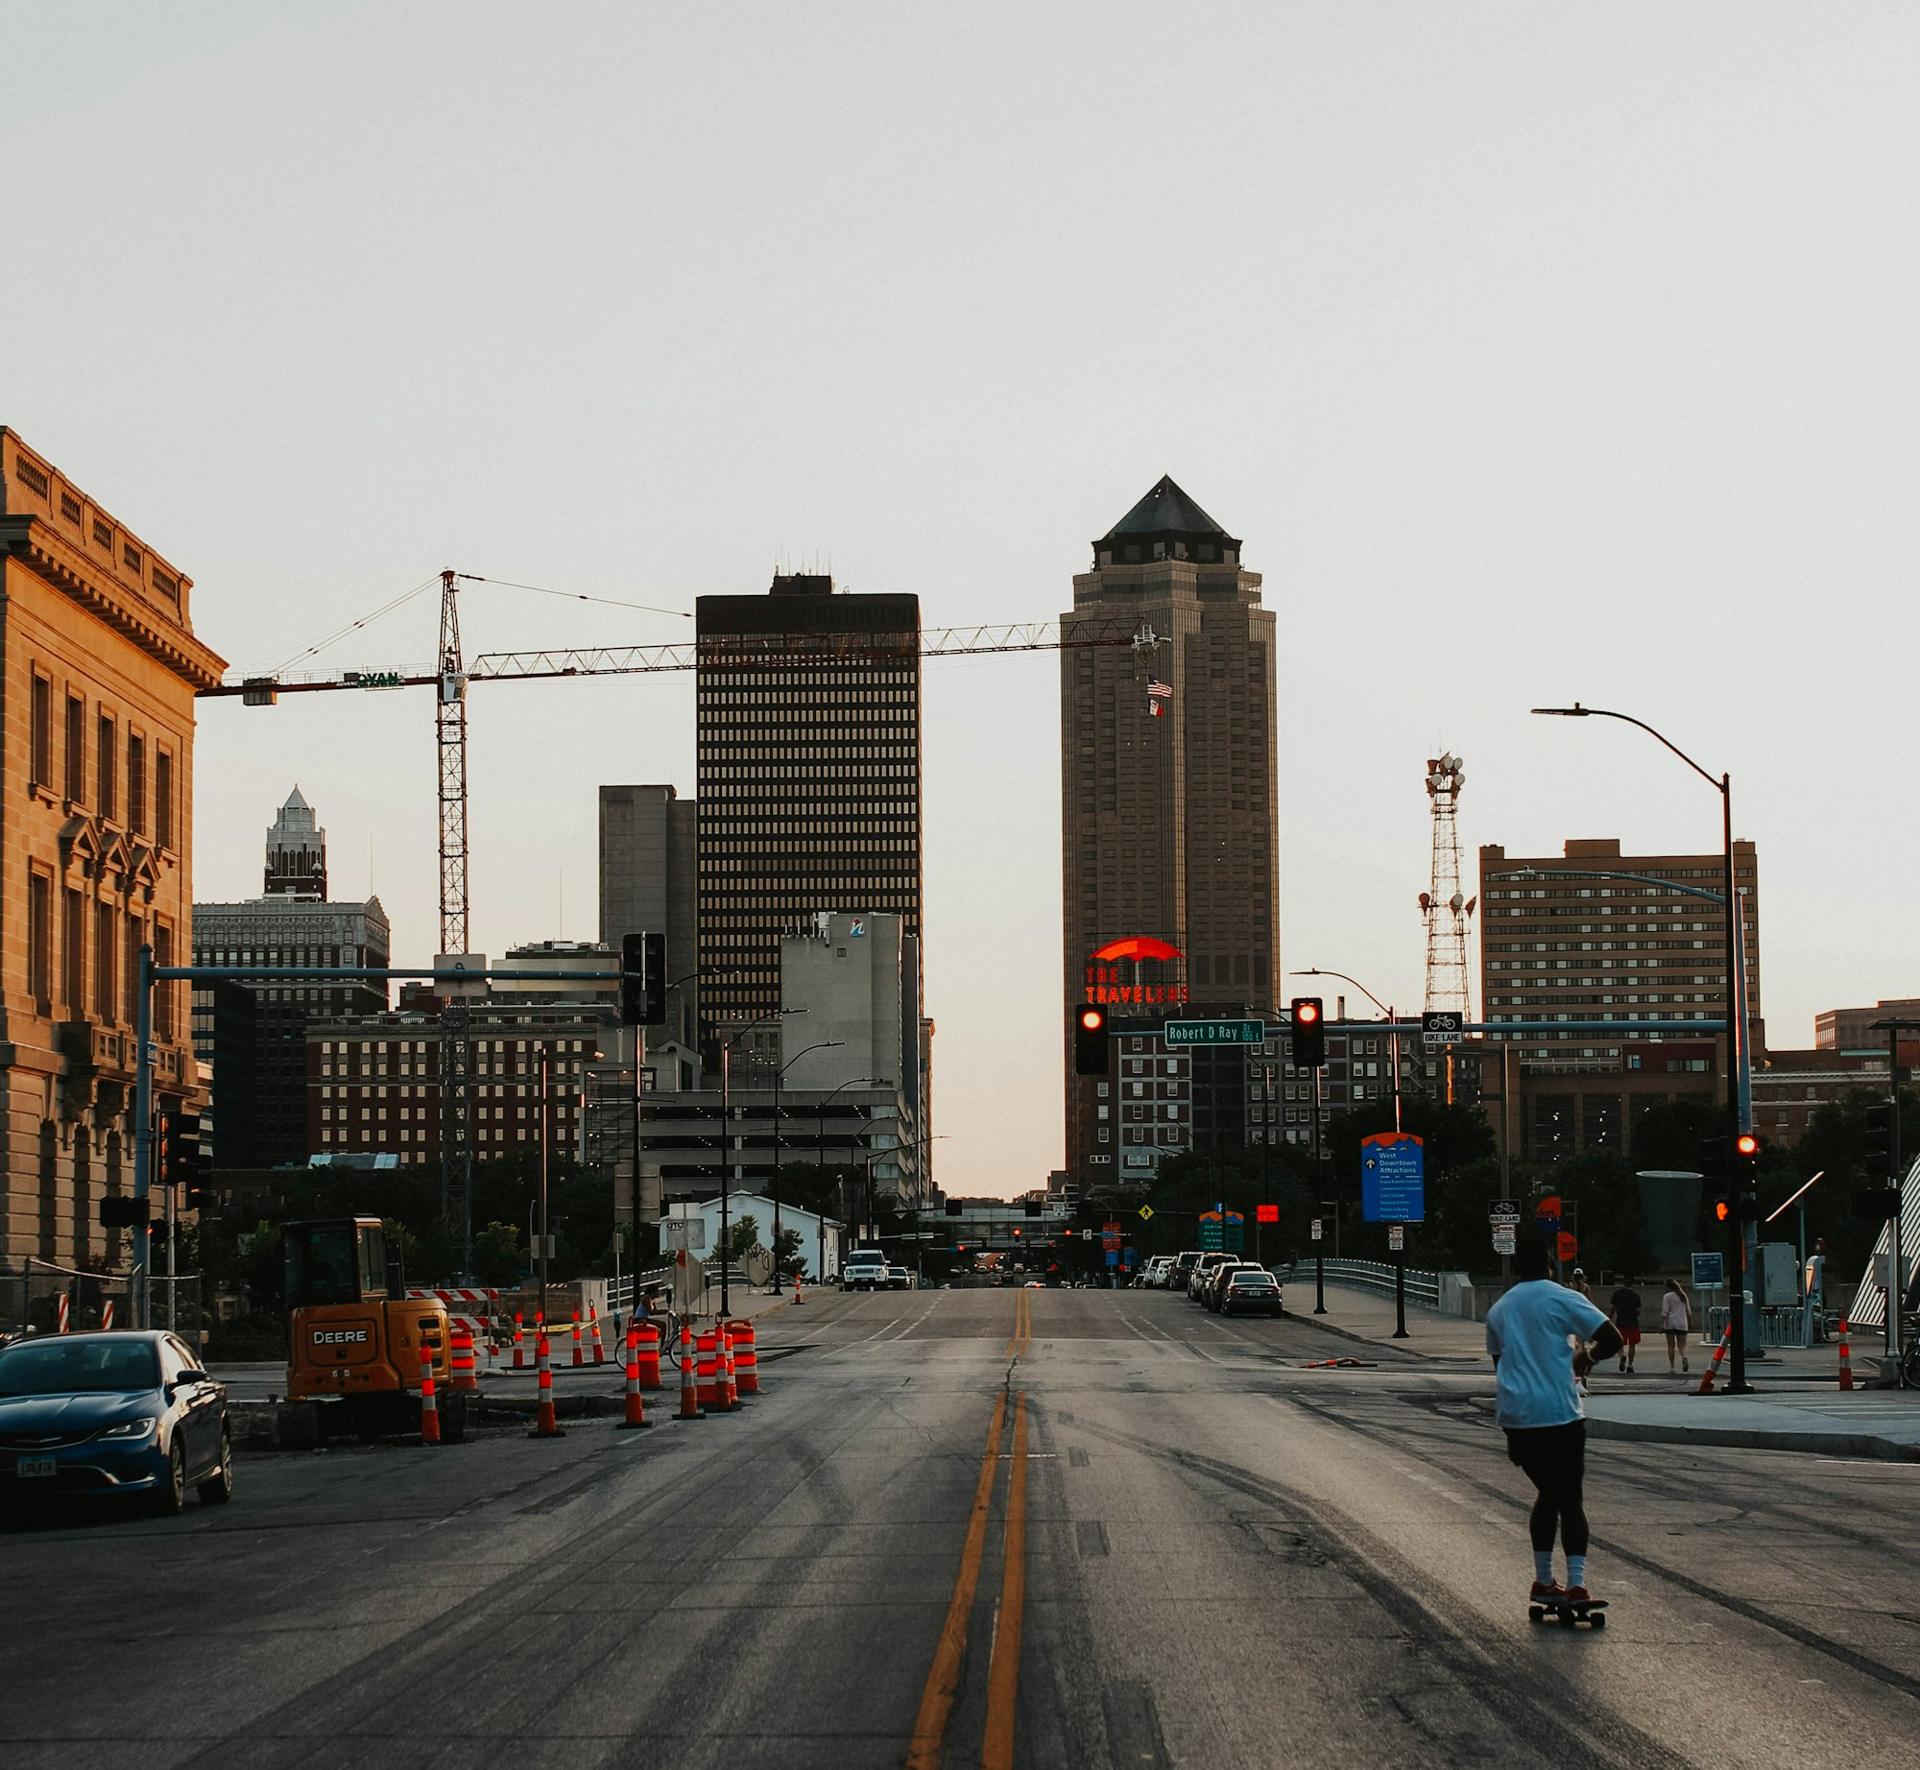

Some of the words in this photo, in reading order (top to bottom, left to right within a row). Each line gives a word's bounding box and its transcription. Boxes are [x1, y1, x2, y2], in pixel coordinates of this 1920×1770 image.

[1087, 967, 1118, 983] THE
[1086, 986, 1190, 1003] TRAVELERS
[1169, 1026, 1204, 1040] Robert
[1208, 1026, 1215, 1039] D
[1219, 1026, 1238, 1041] Ray
[1425, 1033, 1440, 1041] BIKE
[1442, 1033, 1460, 1041] LANE
[313, 1330, 367, 1345] DEERE
